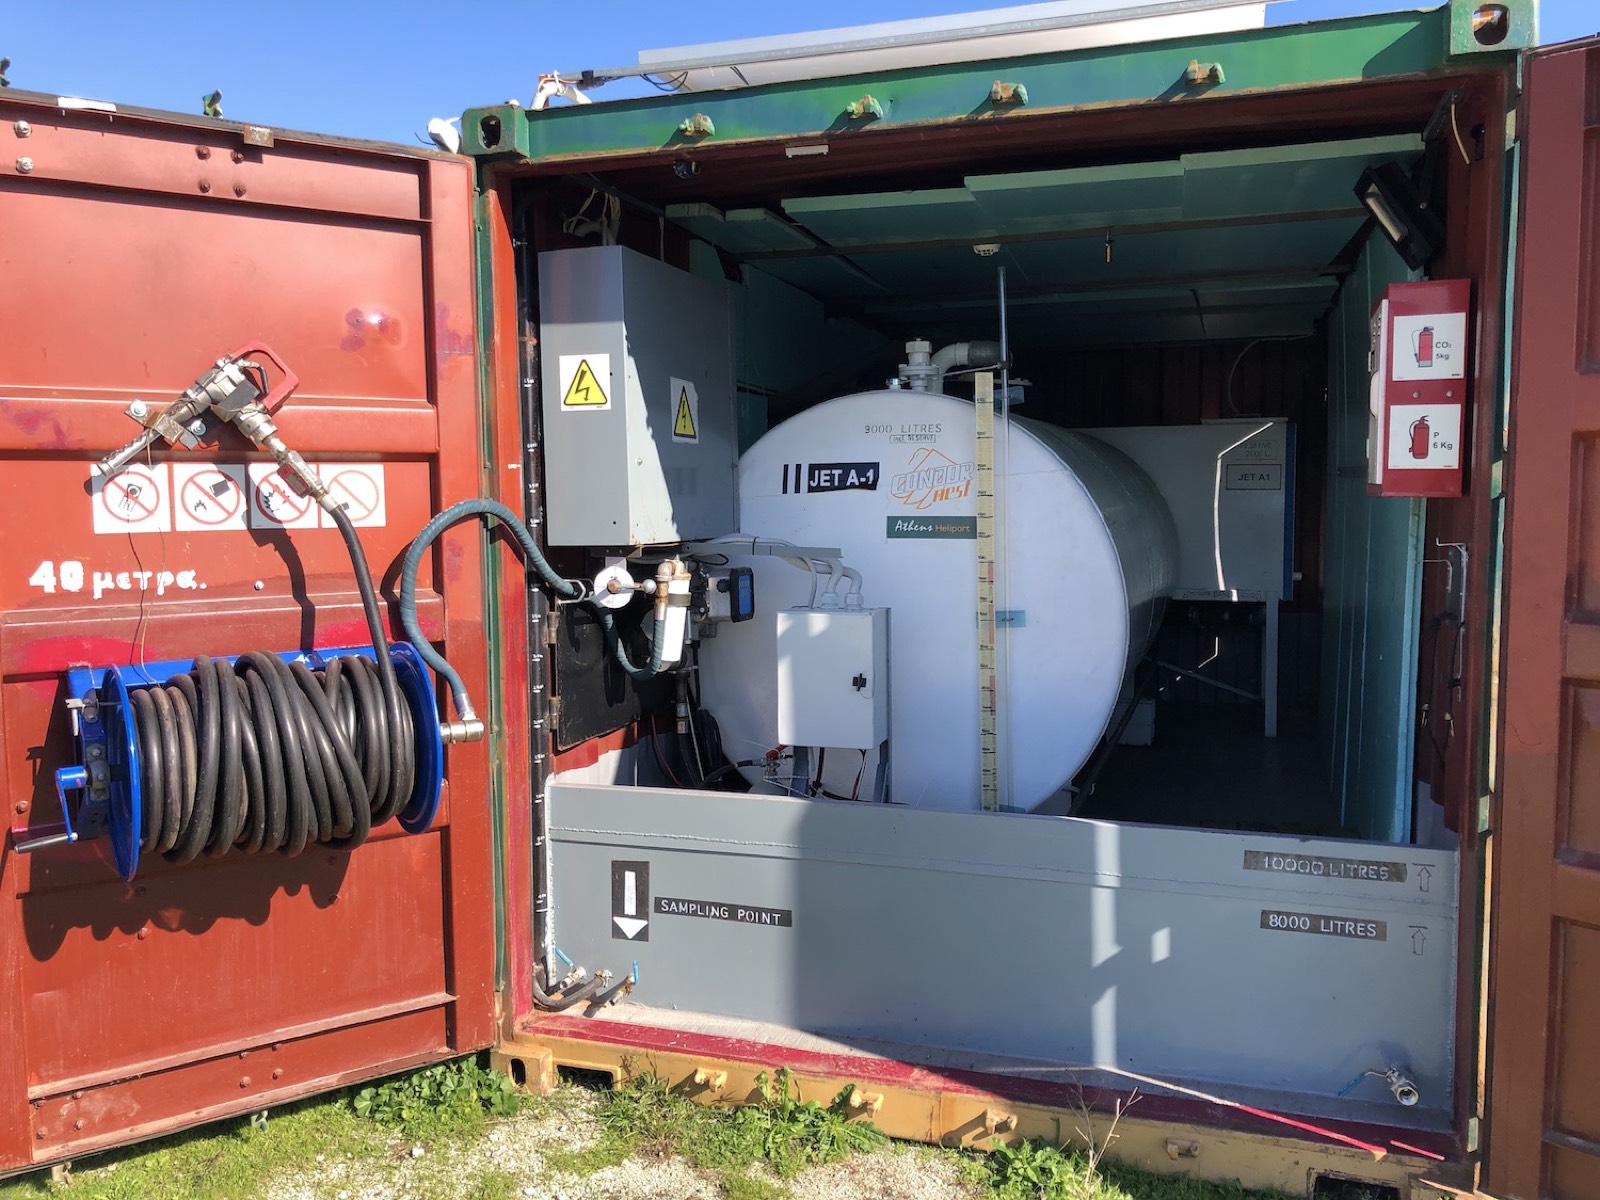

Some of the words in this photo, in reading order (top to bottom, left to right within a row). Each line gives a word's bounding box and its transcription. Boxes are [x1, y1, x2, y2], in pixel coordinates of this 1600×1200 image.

[901, 424, 942, 433] LITRES
[1433, 431, 1440, 439] P
[1433, 441, 1439, 449] 6
[1440, 442, 1453, 451] Kg
[810, 469, 843, 487] JET
[847, 468, 875, 486] A-1
[890, 461, 976, 496] CONDOR
[894, 520, 933, 532] Athens
[935, 524, 971, 532] Heliport
[29, 560, 84, 592] 40
[1263, 856, 1324, 875] 10000
[1329, 863, 1390, 880] LITRES
[661, 900, 729, 918] SAMPLING
[737, 909, 781, 925] POINT
[1269, 914, 1310, 930] 8000
[1320, 919, 1377, 937] LITRES
